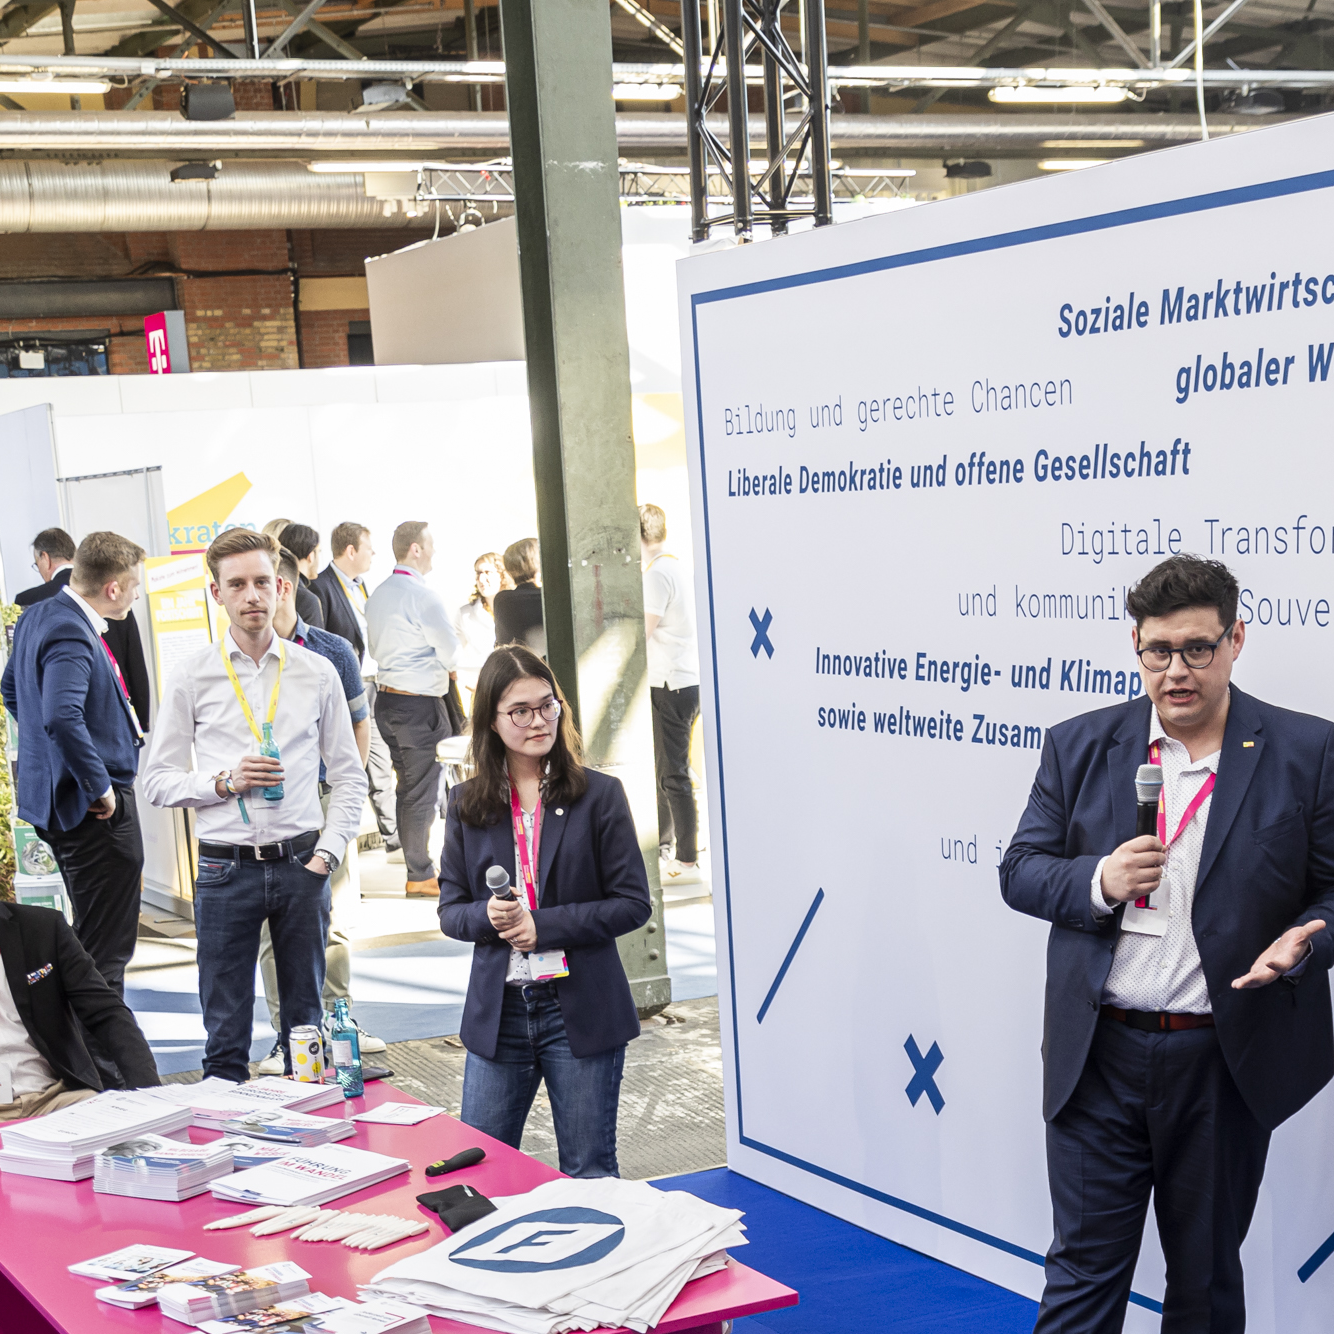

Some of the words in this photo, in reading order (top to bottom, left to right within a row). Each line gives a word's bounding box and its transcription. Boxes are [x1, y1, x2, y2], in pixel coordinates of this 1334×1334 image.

[1058, 290, 1150, 338] Soziale
[1175, 348, 1295, 404] globaler
[724, 403, 796, 438] Bildung
[810, 395, 843, 429] und
[857, 386, 955, 432] gerechte
[971, 377, 1073, 413] Chancen
[728, 466, 792, 497] Liberale
[799, 458, 903, 494] Demokratie
[910, 454, 947, 488] und
[955, 451, 1025, 486] offene
[1034, 437, 1192, 483] Gesellschaft
[1061, 518, 1182, 564] Digitale
[958, 584, 997, 617] und
[815, 646, 908, 680] Innovative
[915, 652, 1002, 692] Energie-
[1010, 657, 1052, 690] und
[1059, 659, 1142, 701] Klimap
[817, 702, 866, 731] sowie
[873, 706, 964, 741] weltweite
[971, 713, 1048, 750] Zusam
[941, 834, 977, 864] und
[493, 1229, 579, 1254] F
